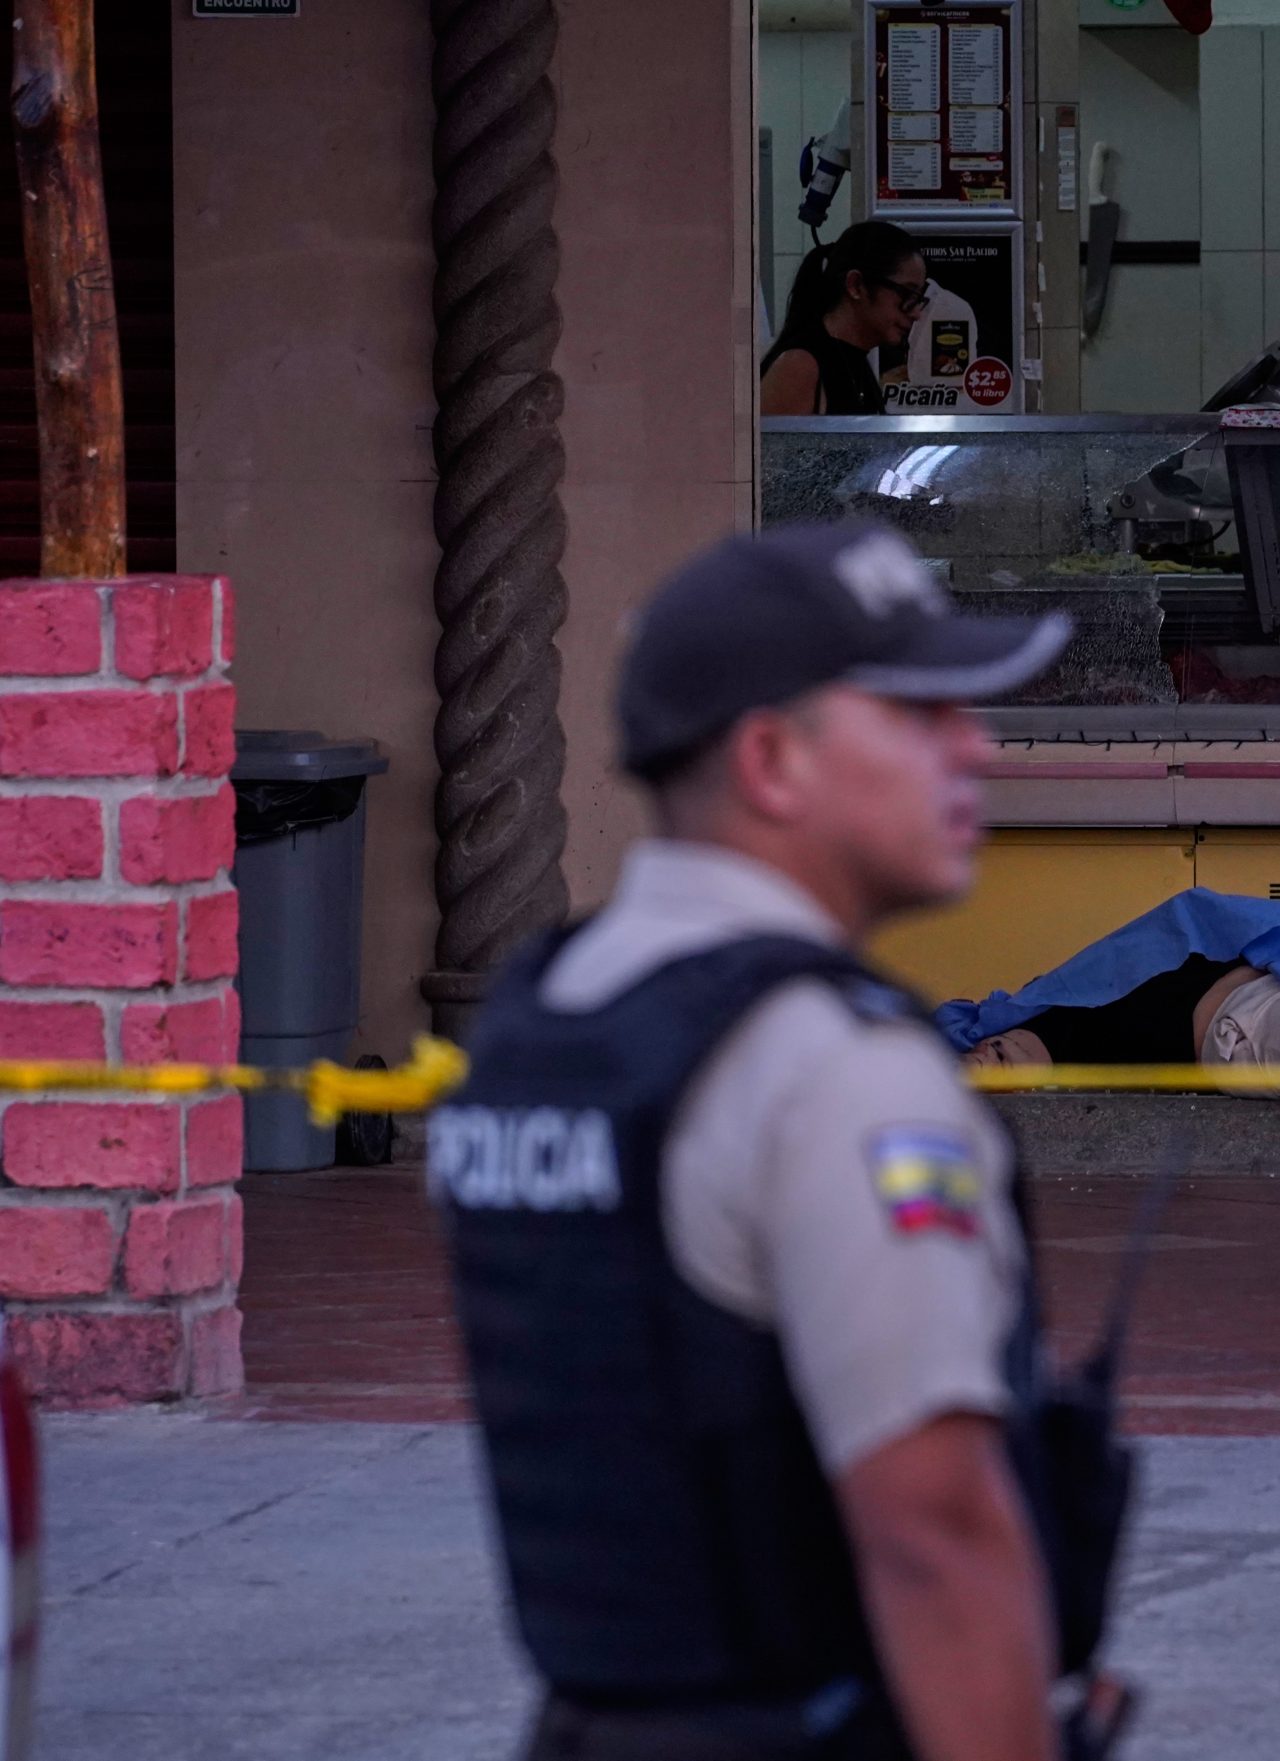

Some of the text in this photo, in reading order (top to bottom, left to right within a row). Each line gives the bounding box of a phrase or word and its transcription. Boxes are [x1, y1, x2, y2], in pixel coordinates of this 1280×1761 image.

[883, 383, 958, 406] Picaña
[972, 389, 1006, 397] la libra
